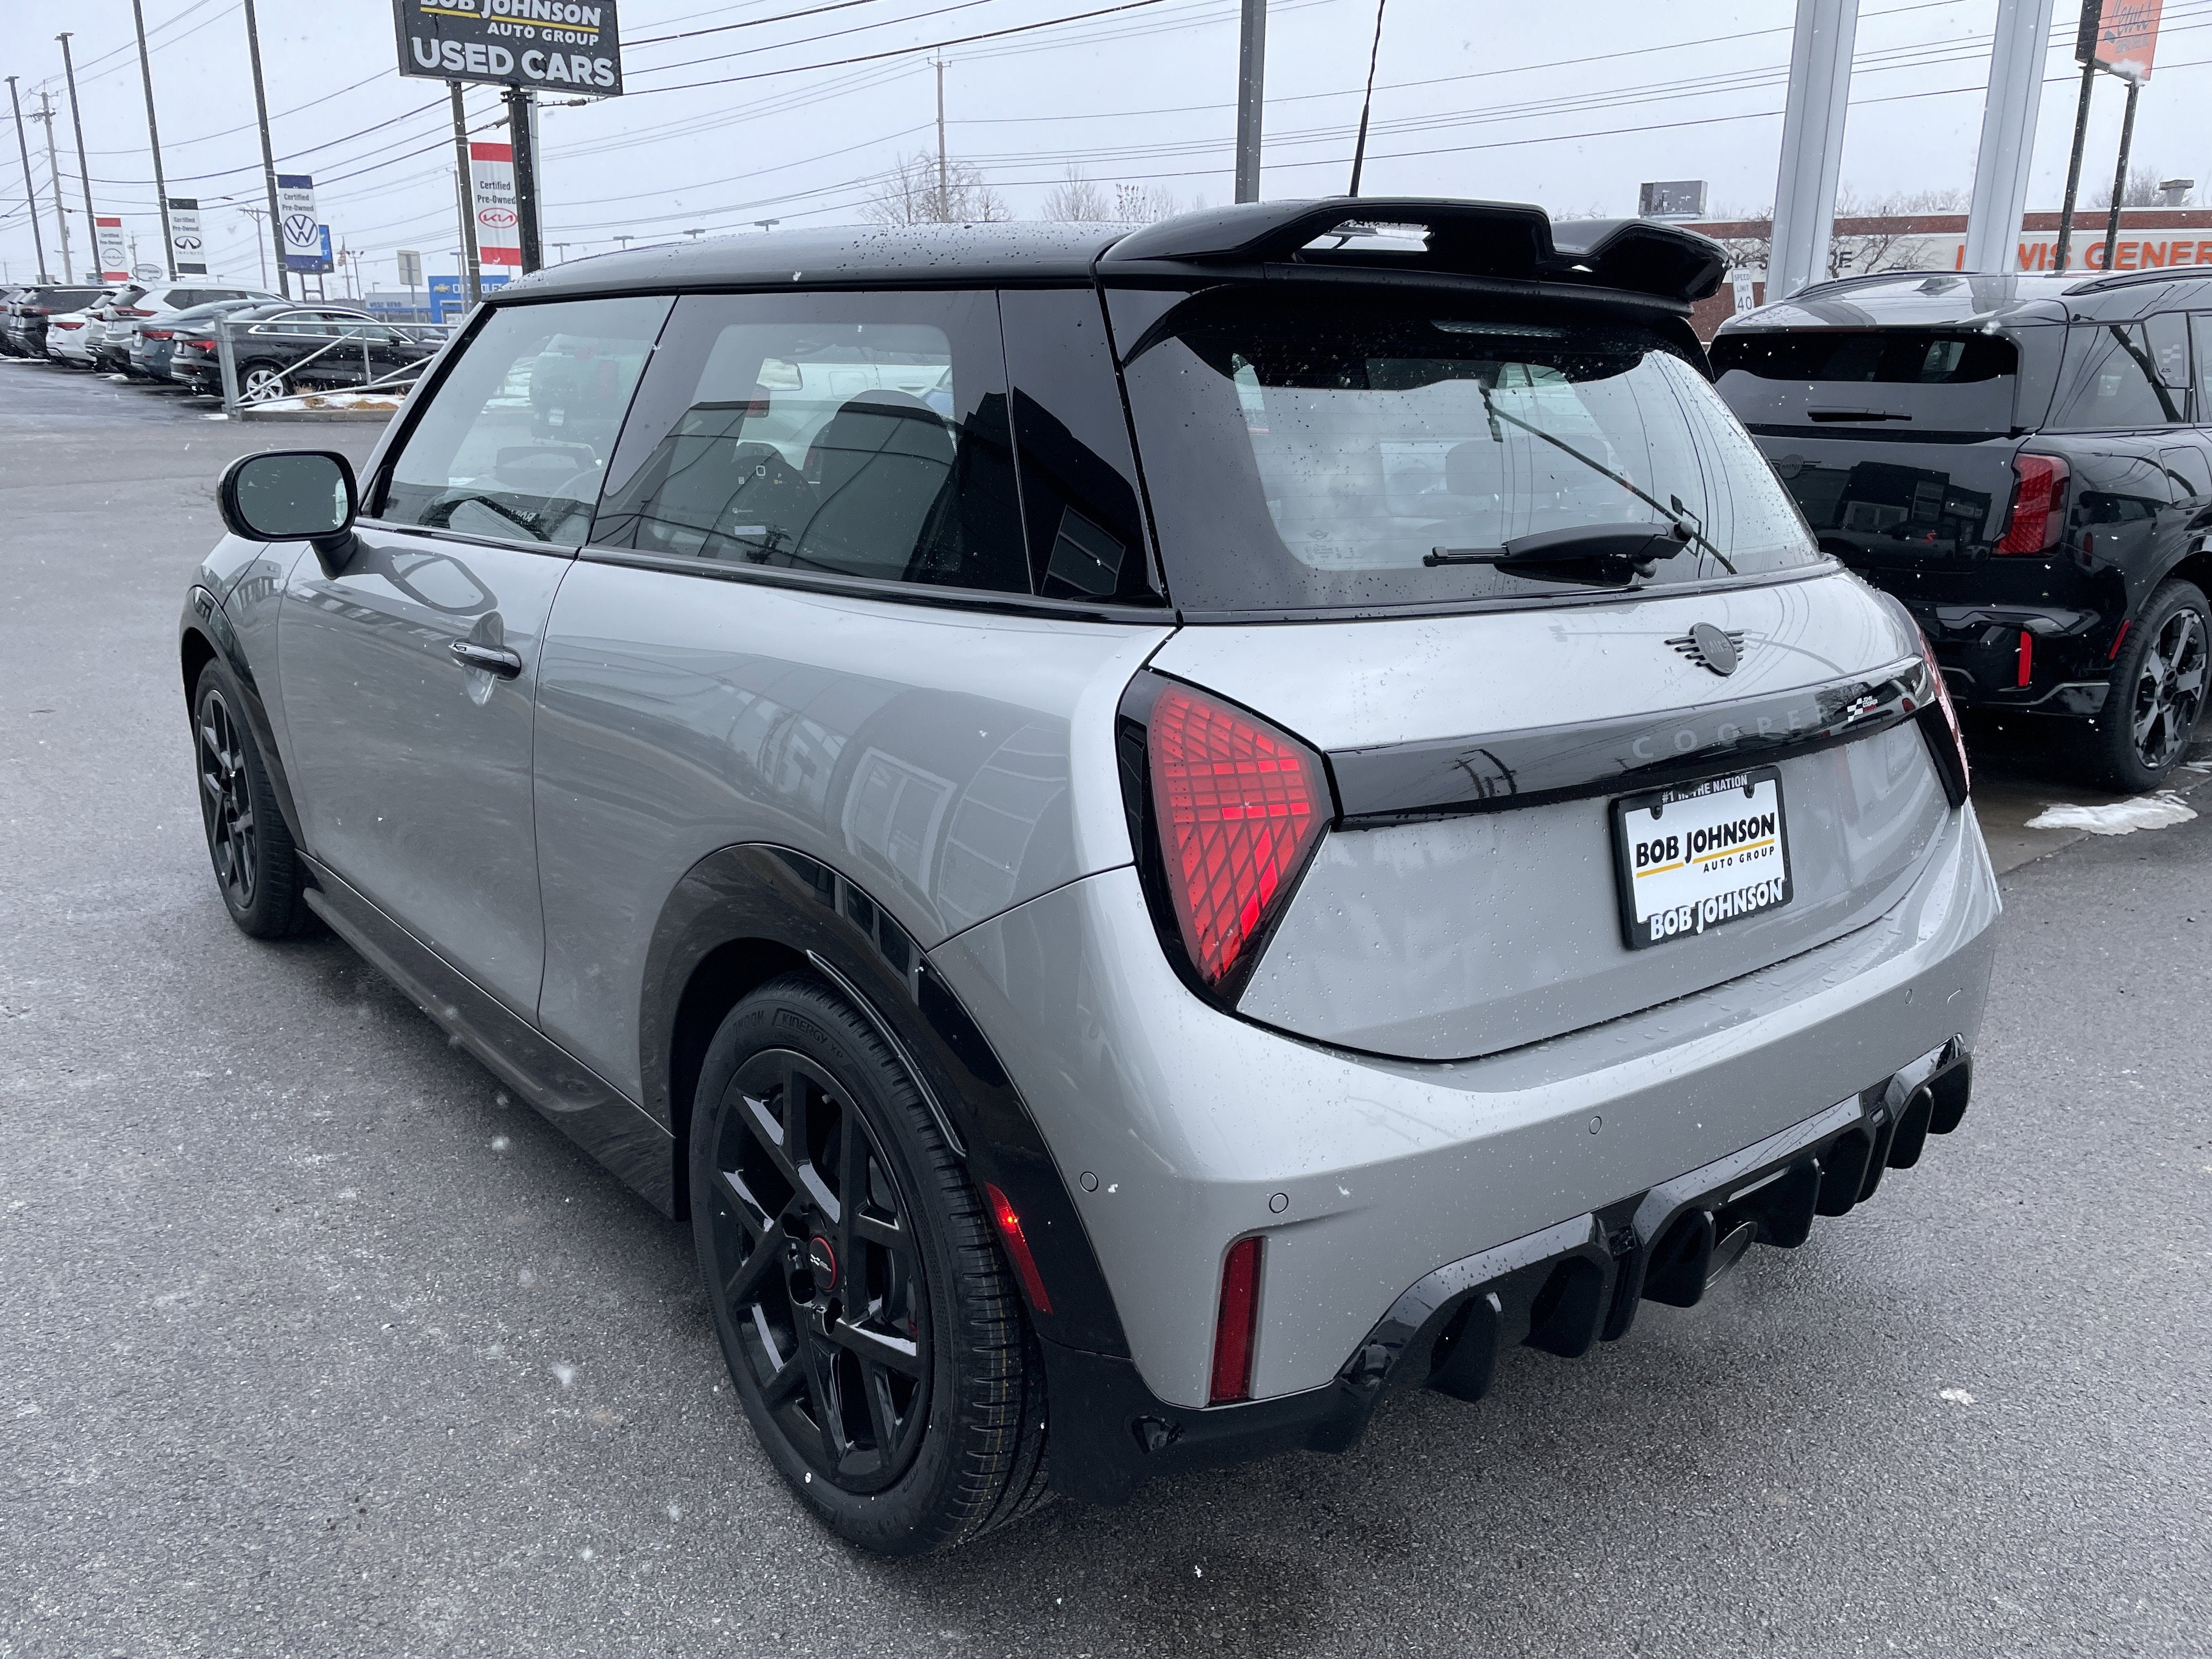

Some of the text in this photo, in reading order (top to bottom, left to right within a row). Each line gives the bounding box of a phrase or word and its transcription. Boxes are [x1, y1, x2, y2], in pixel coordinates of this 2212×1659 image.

[482, 0, 601, 26] JOHNSON
[487, 22, 599, 46] AUTO GROUP
[411, 37, 615, 87] USED CARS
[480, 180, 511, 190] Certified
[1734, 273, 1750, 281] SPEED
[1737, 296, 1752, 311] 40
[1632, 704, 1832, 759] COOPER
[1662, 790, 1674, 804] #1
[1713, 775, 1747, 792] NATION
[1636, 812, 1775, 868] BOB JOHNSON
[1703, 846, 1774, 873] AUTO GROUP
[1650, 879, 1783, 941] BOB JOHNSON
